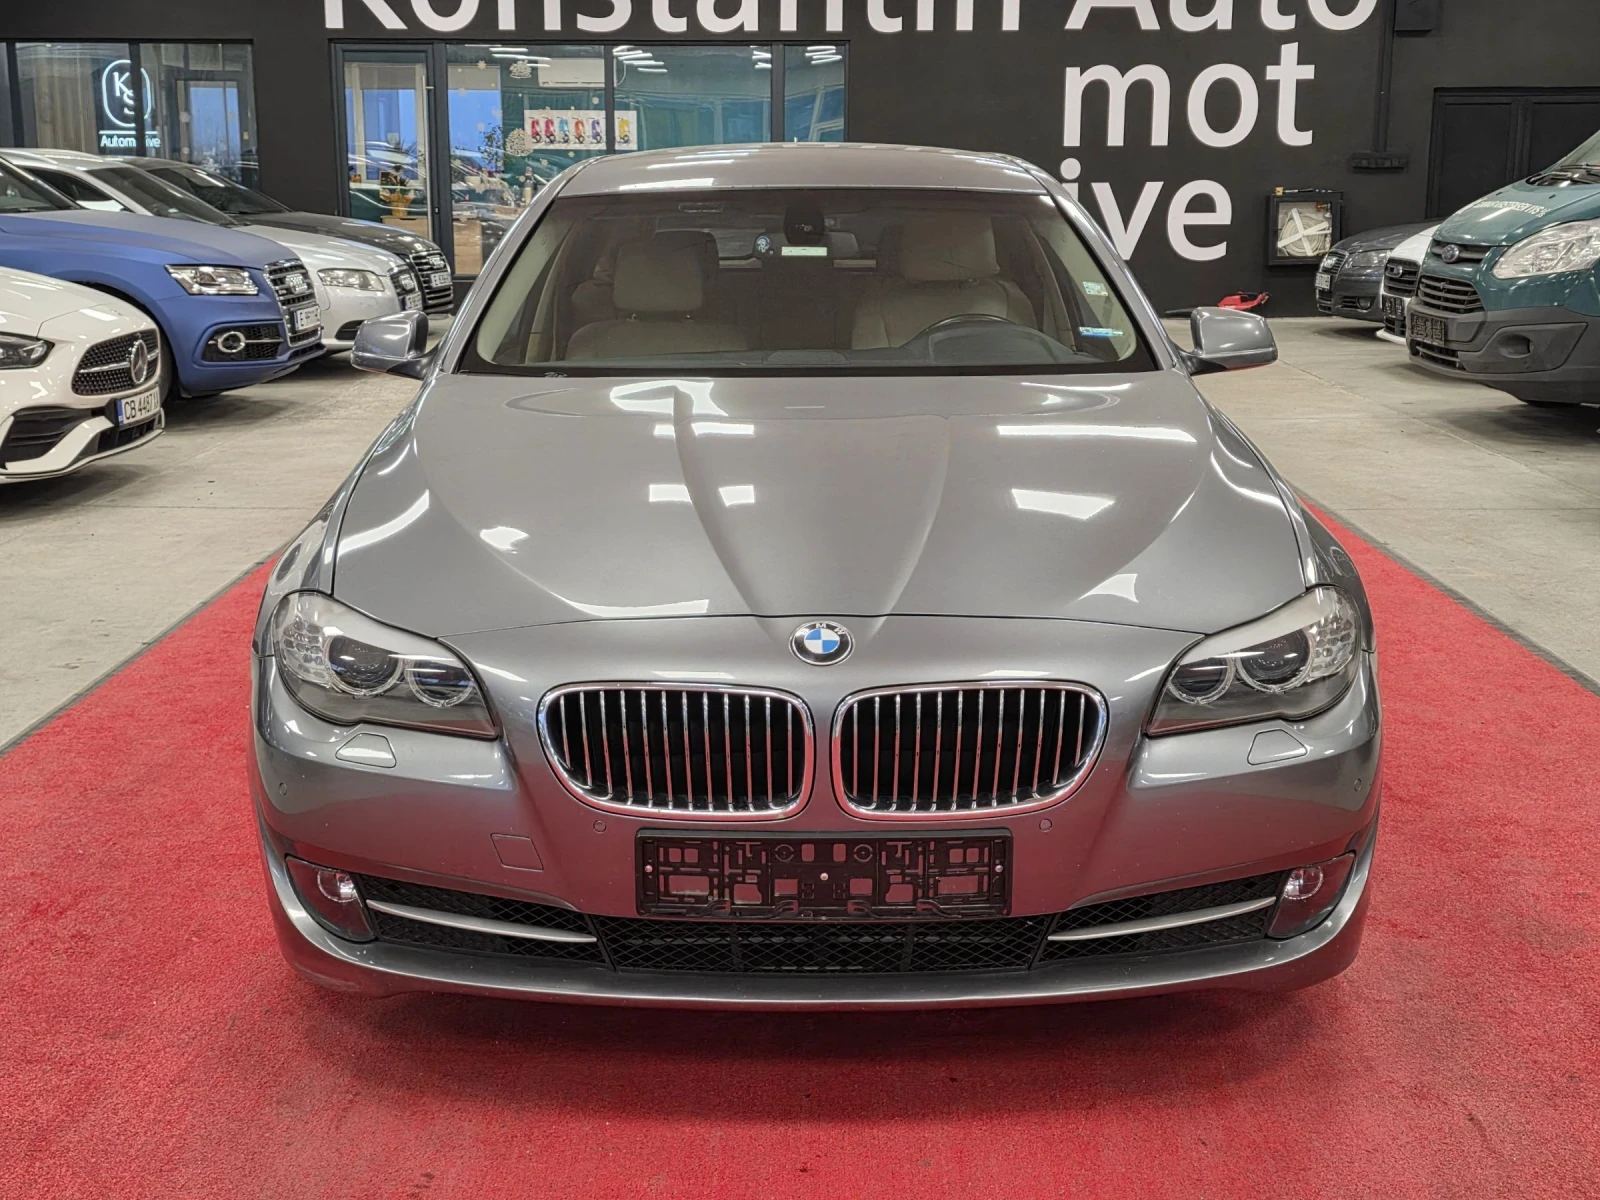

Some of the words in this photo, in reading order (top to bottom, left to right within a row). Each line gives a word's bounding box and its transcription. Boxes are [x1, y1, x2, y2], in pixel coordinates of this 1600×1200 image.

[1063, 42, 1316, 148] mot
[101, 135, 161, 147] Automive
[798, 622, 846, 635] MW
